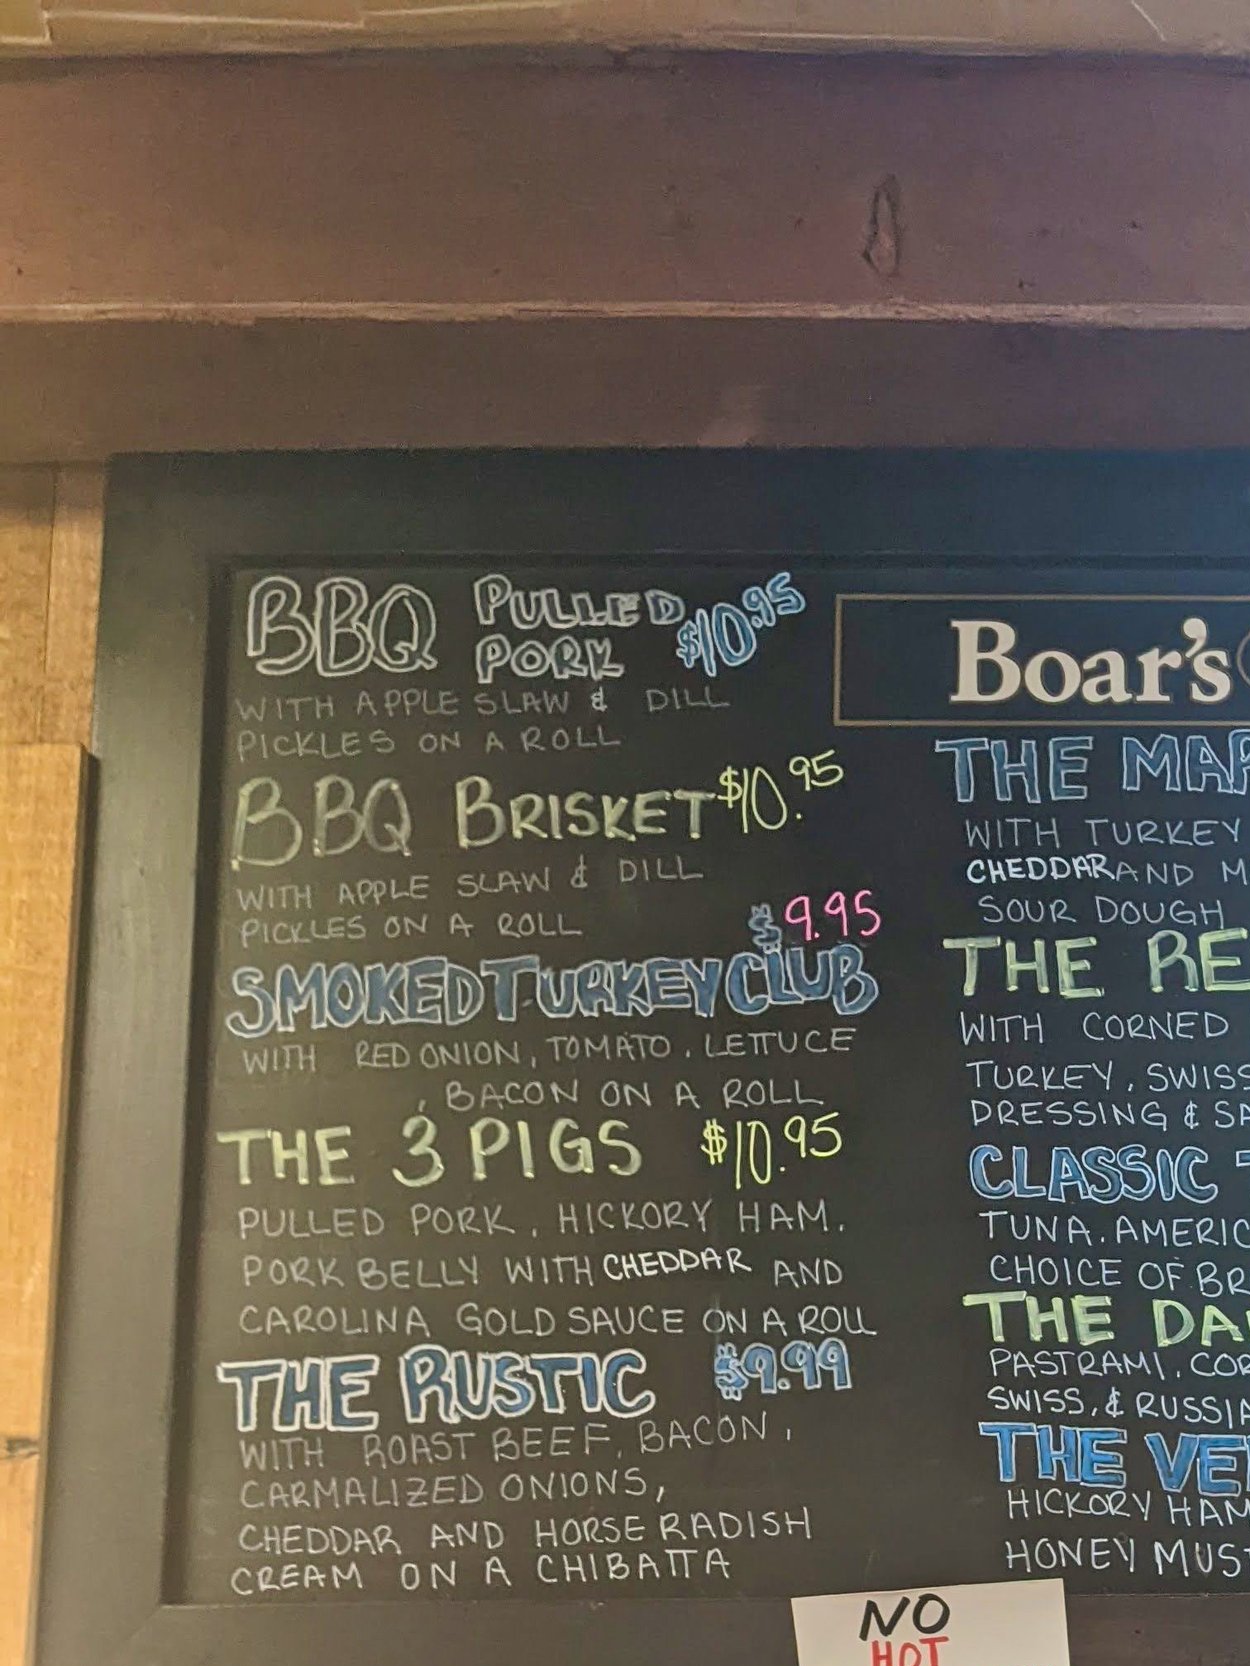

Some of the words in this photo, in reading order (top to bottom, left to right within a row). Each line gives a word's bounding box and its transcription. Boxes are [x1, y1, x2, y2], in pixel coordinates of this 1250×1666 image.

[247, 575, 437, 676] BBQ
[474, 573, 686, 629] PULLED
[474, 633, 623, 684] PORK
[949, 617, 1232, 704] Boar's
[236, 696, 334, 725] WITH
[357, 690, 459, 716] APPLE
[475, 691, 568, 714] SLAW
[646, 686, 730, 713] DILL
[237, 727, 395, 759] PICKLES
[419, 731, 461, 754] ON
[485, 728, 504, 753] A
[523, 725, 621, 751] ROLL
[935, 735, 1093, 804] THE
[230, 775, 412, 871] BBQ
[456, 775, 715, 848] BRISKET
[236, 882, 312, 911] WITH
[337, 874, 429, 902] APPLE
[457, 866, 549, 896] SLAW
[619, 855, 704, 884] DILL
[966, 854, 1116, 884] CHEDDAR
[1115, 861, 1195, 886] AND
[241, 914, 367, 948] PICKLES
[385, 914, 426, 940] ON
[449, 913, 474, 937] A
[498, 910, 582, 937] ROLL
[977, 895, 1077, 925] SOUR
[1095, 895, 1225, 928] DOUGH
[227, 957, 486, 1037] SMOKED
[482, 956, 725, 1021] TURKEY
[725, 944, 880, 1015] CLUB
[943, 936, 1105, 999] THE
[970, 1100, 1167, 1132] DRESSING
[1184, 1101, 1198, 1130] &
[217, 1125, 354, 1185] THE
[393, 1117, 444, 1188] 3
[470, 1117, 643, 1181] PIGS
[701, 1112, 842, 1189] $10.95
[969, 1144, 1218, 1204] CLASSIC
[244, 1256, 345, 1287] PORK
[357, 1257, 480, 1290] BELLY
[505, 1257, 593, 1286] WITH
[602, 1247, 752, 1281] CHEDDAR
[773, 1262, 844, 1289] AND
[990, 1255, 1122, 1287] CHOICE
[1139, 1262, 1185, 1289] OF
[239, 1304, 430, 1336] CAROLINA
[457, 1304, 556, 1336] GOLD
[568, 1307, 686, 1335] SAUCE
[704, 1308, 747, 1336] ON
[762, 1306, 788, 1336] A
[800, 1305, 877, 1336] ROLL
[963, 1290, 1115, 1346] THE
[217, 1354, 379, 1433] THE
[400, 1344, 655, 1426] RUSTIC
[978, 1421, 1127, 1488] THE
[230, 1563, 363, 1597] CREAM
[401, 1559, 458, 1591] ON
[484, 1557, 511, 1588] A
[536, 1548, 731, 1586] CHIBATTA
[1005, 1537, 1135, 1573] HONEY
[859, 1593, 950, 1641] NO
